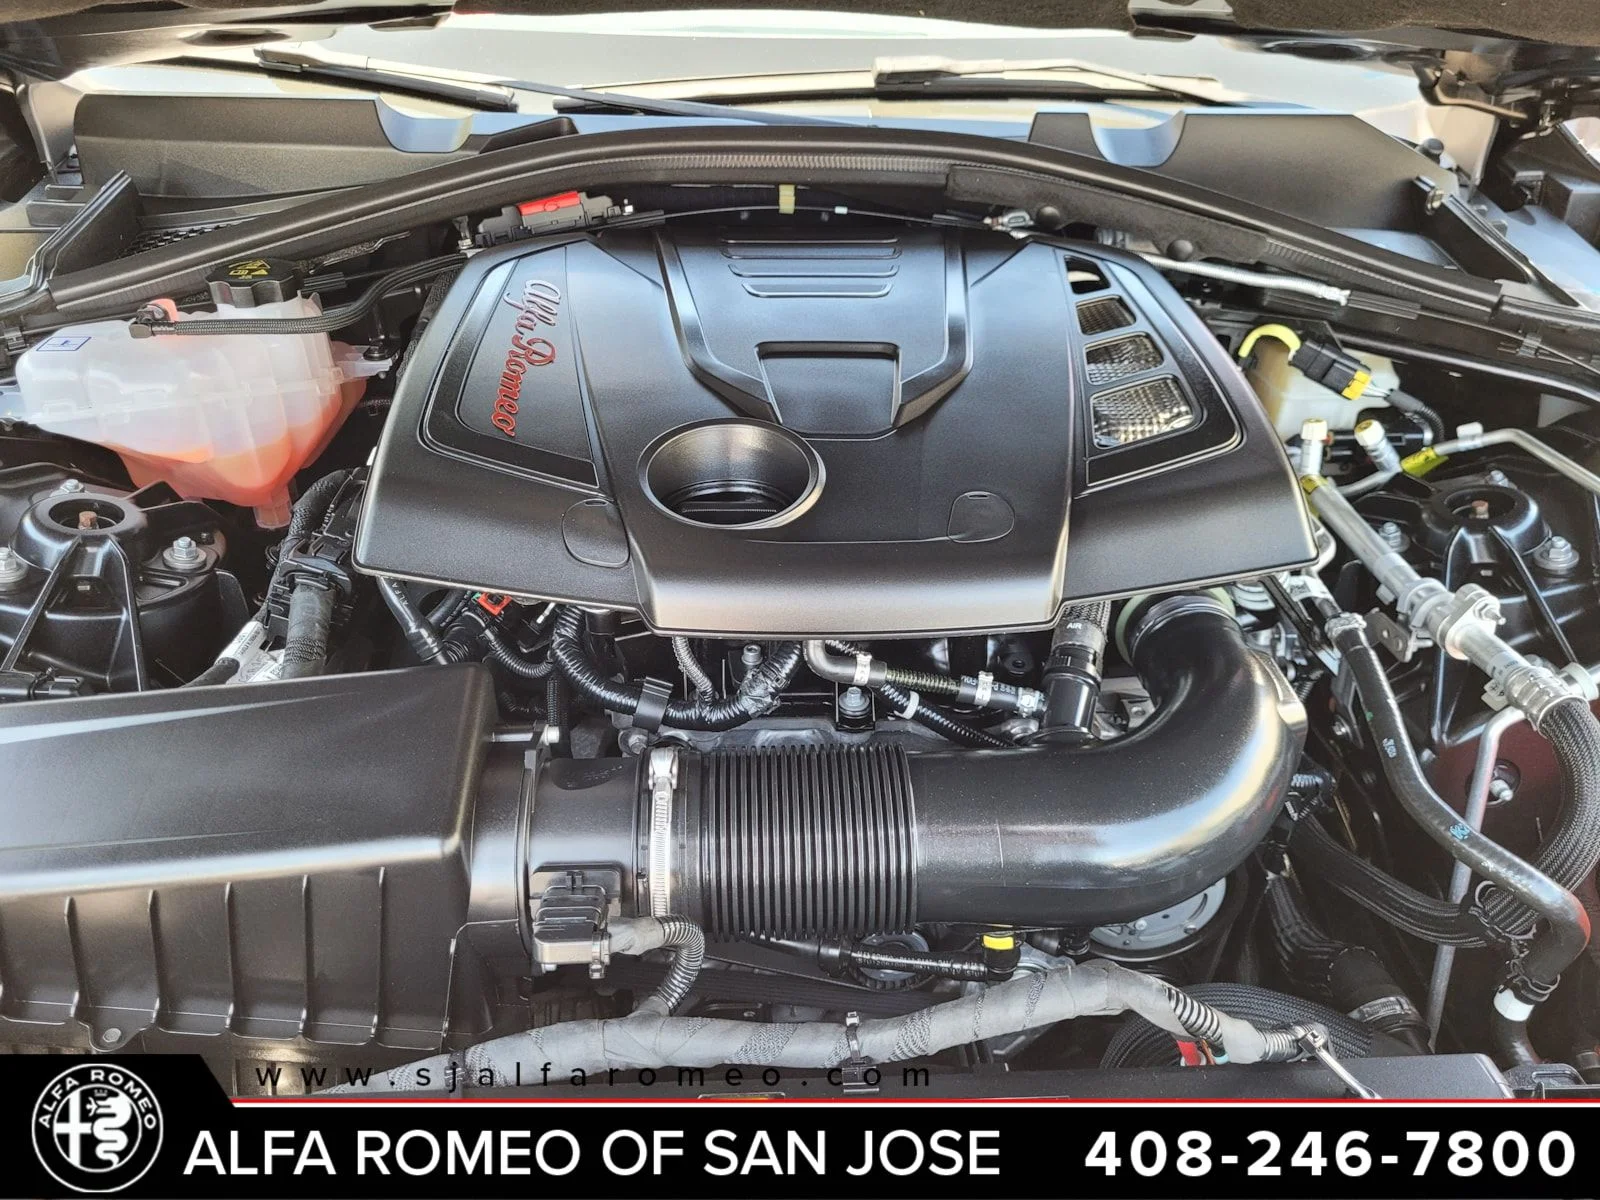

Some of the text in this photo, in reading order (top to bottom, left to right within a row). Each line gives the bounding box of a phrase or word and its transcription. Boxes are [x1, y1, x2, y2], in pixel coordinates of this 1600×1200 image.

[491, 279, 561, 437] Alfa Romeo
[1066, 622, 1083, 630] AIR
